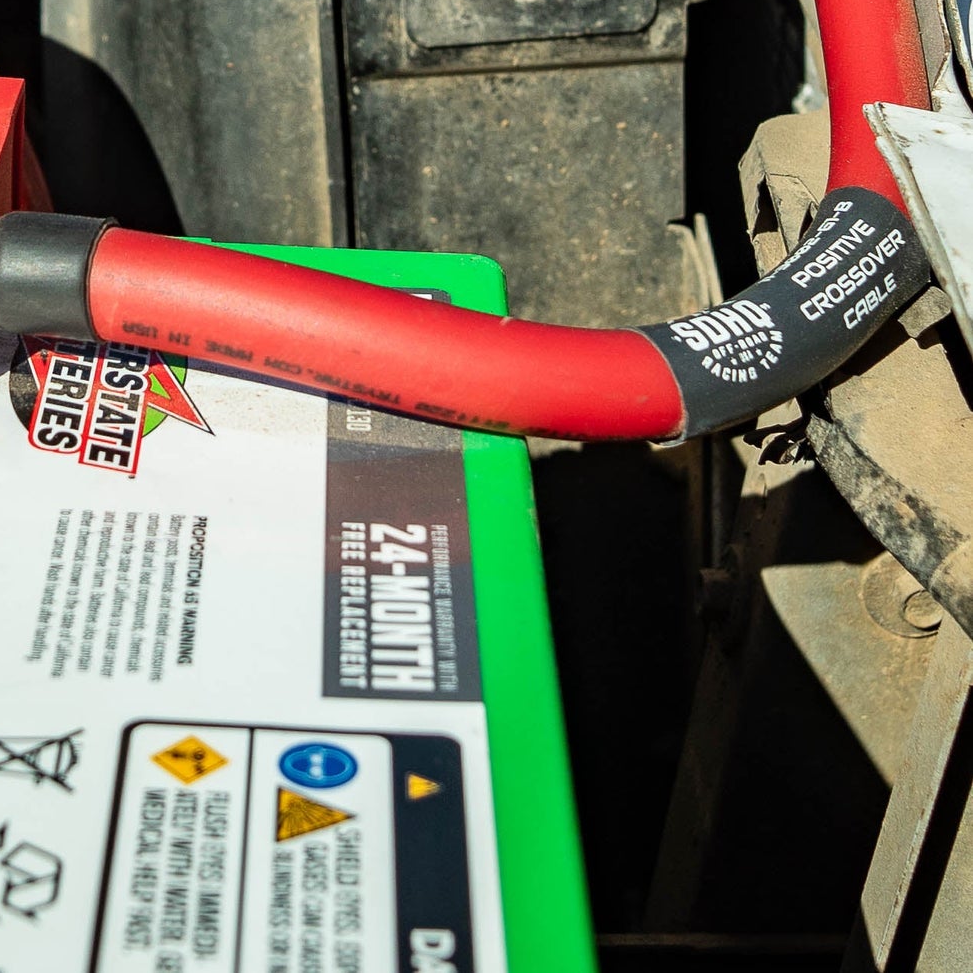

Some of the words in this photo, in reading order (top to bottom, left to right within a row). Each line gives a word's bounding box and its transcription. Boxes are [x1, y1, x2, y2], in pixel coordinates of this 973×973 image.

[792, 218, 876, 289] POSITIVE
[799, 229, 906, 322] CROSSOVER
[843, 272, 897, 331] CABLE
[121, 321, 159, 341] USA
[670, 300, 775, 351] SDHQ
[168, 331, 192, 349] IN
[204, 339, 254, 362] MADE
[712, 331, 769, 360] OFF-ROAD
[702, 355, 758, 383] RACING
[759, 330, 783, 370] TEAM
[37, 341, 98, 451] TERIES
[88, 341, 149, 468] ERSTATE
[56, 516, 70, 535] cause
[81, 510, 95, 527] other
[103, 511, 116, 523] and
[125, 512, 143, 533] known
[146, 513, 161, 537] contain
[166, 514, 186, 537] Battery
[74, 528, 92, 561] chemicals
[94, 524, 115, 567] reproductive
[121, 543, 137, 554] the
[144, 538, 159, 553] lead
[185, 516, 208, 587] PROPOSITION
[340, 521, 366, 561] FREE
[48, 562, 65, 582] Wash
[117, 556, 132, 573] state
[142, 554, 157, 568] and
[430, 525, 452, 595] PERFORMANCE
[70, 563, 87, 587] known
[116, 574, 130, 582] of
[140, 569, 155, 585] lead
[160, 560, 178, 593] terminals
[42, 583, 60, 606] hands
[65, 598, 81, 610] the
[86, 591, 106, 623] Batteries
[111, 582, 130, 618] California
[160, 594, 174, 609] and
[184, 590, 199, 604] 65
[370, 522, 435, 692] 24-MONTH
[38, 607, 55, 624] after
[61, 611, 78, 629] state
[108, 619, 122, 627] to
[155, 610, 173, 636] related
[339, 565, 367, 689] REPLACEMENT
[435, 598, 457, 657] WARRANTY
[83, 625, 99, 640] also
[106, 628, 119, 650] cause
[177, 606, 197, 666] WARNING
[52, 640, 75, 678] California
[77, 642, 96, 671] contain
[101, 651, 116, 678] cancer
[126, 633, 145, 673] chemicals
[149, 637, 167, 683] accessories
[438, 659, 459, 692] WITH
